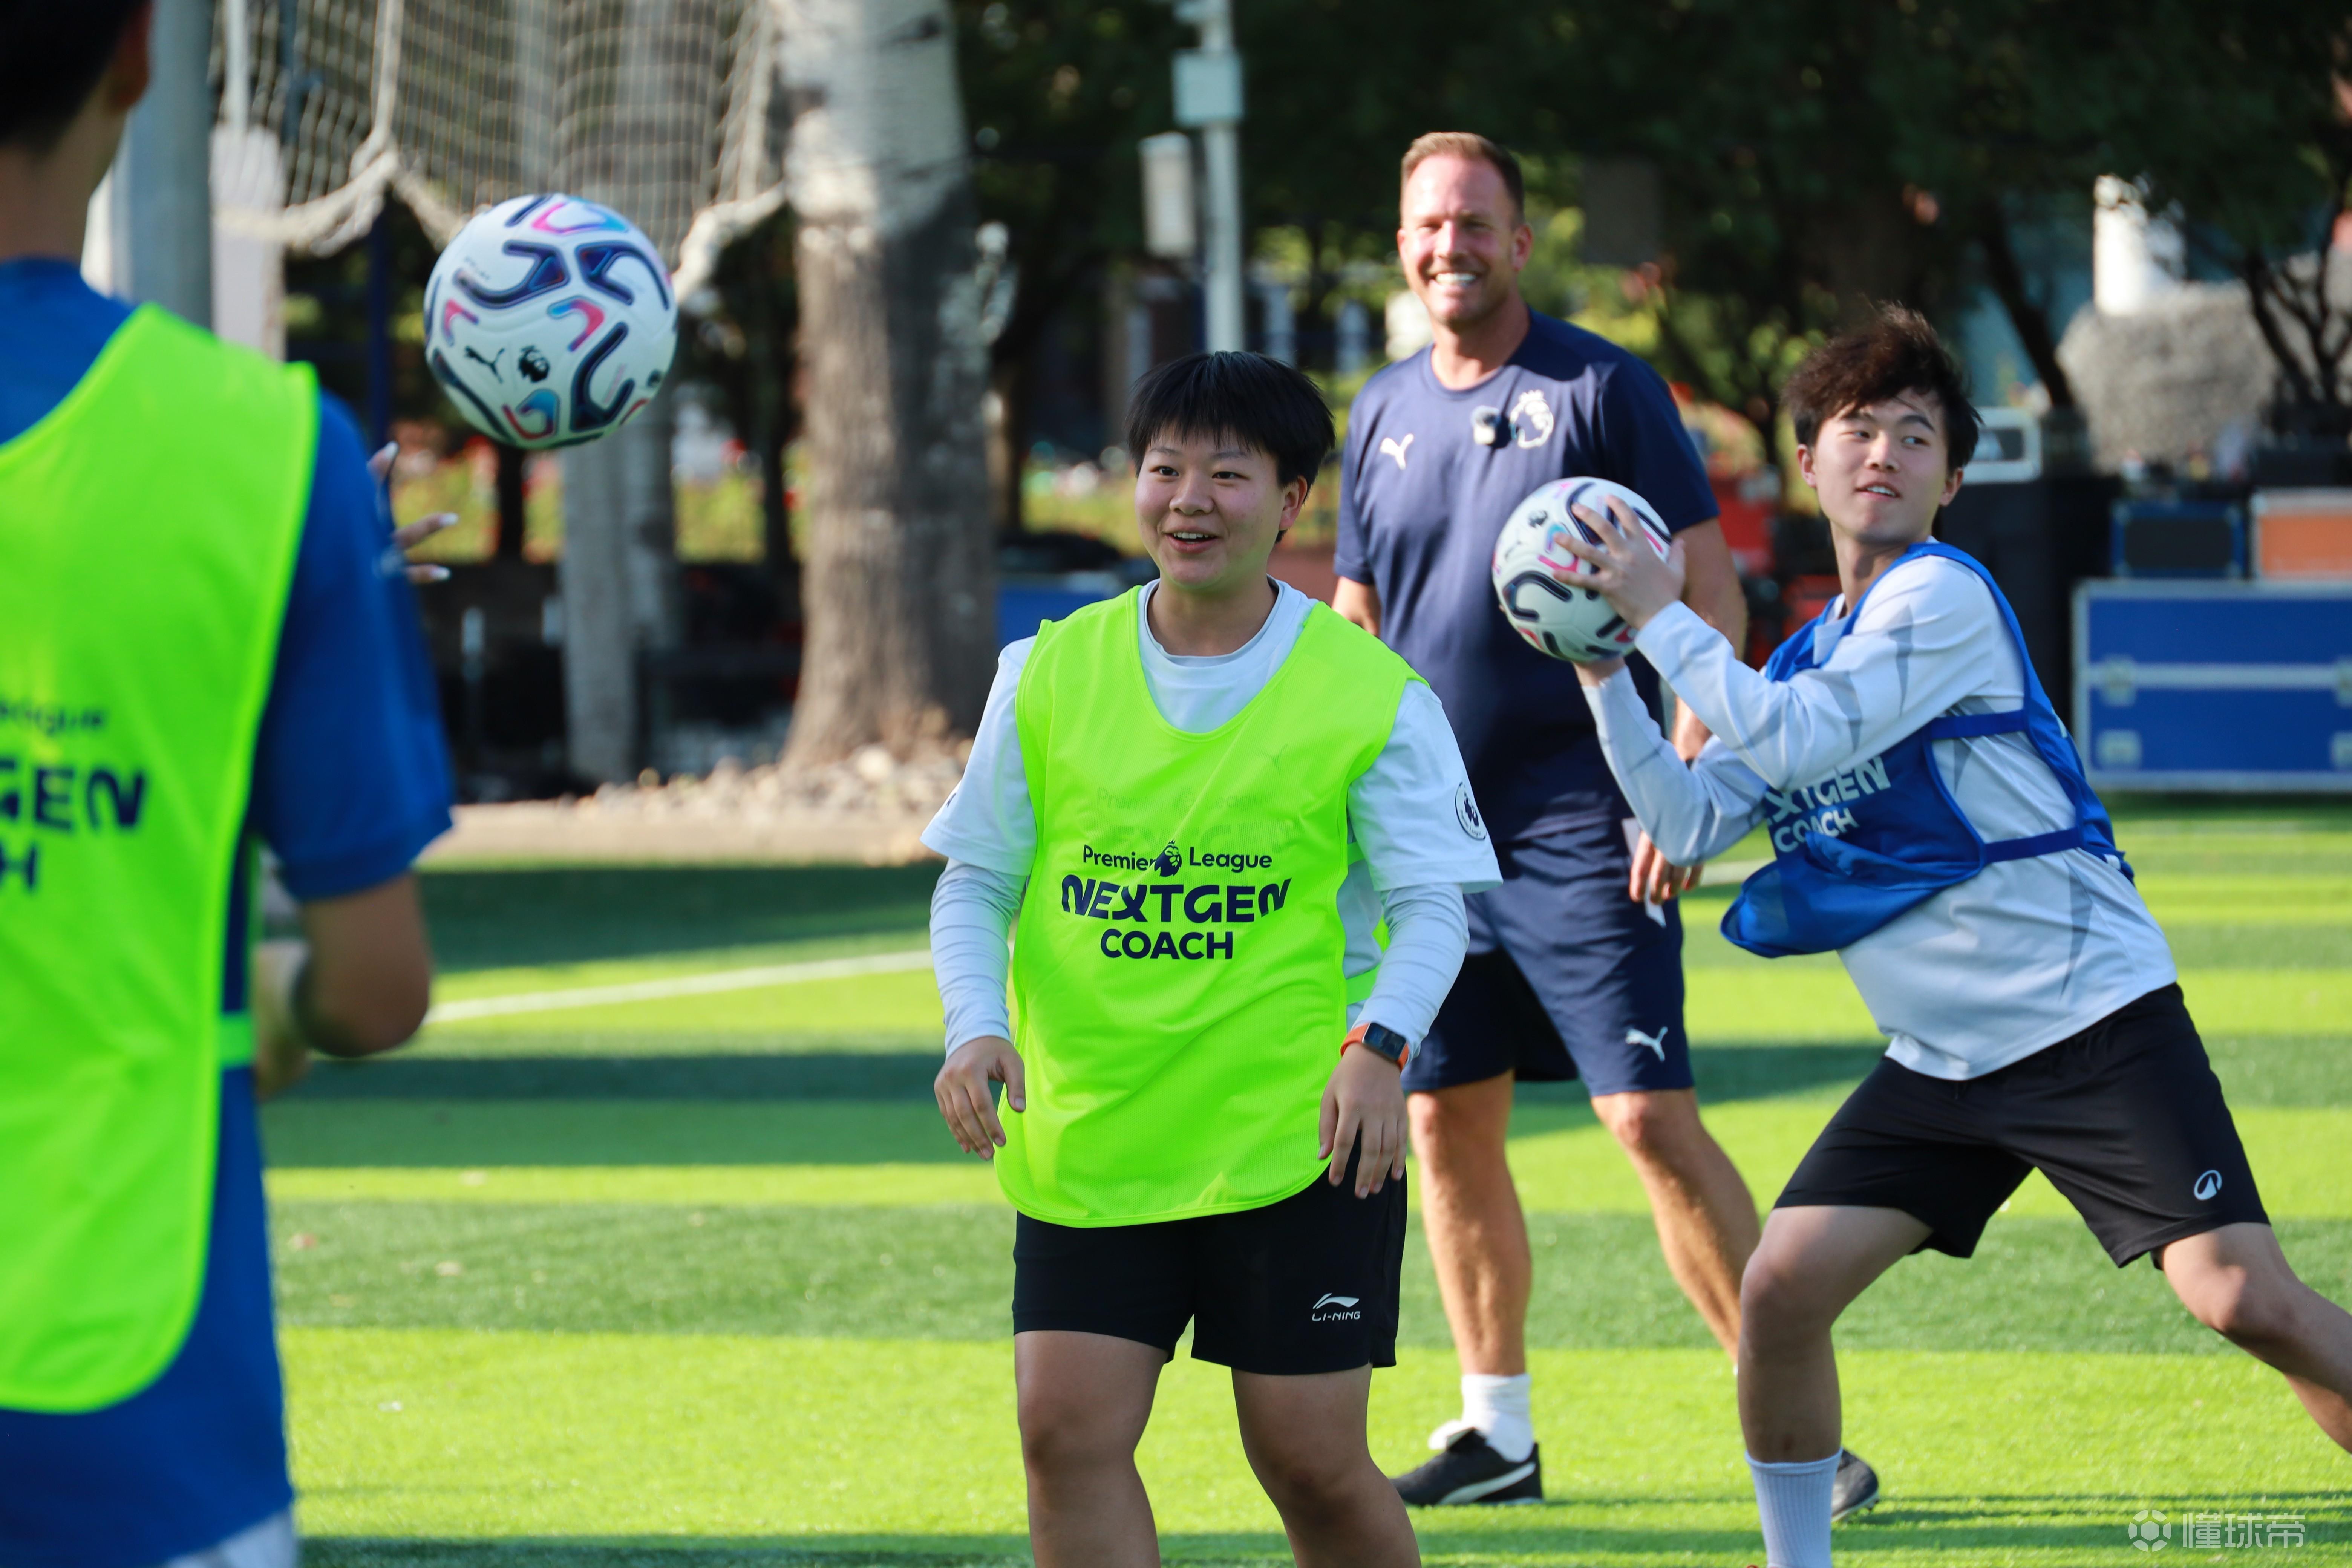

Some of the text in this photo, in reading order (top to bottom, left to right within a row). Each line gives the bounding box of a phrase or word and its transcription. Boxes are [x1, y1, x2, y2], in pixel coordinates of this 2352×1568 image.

[1083, 844, 1272, 873] Premier League
[1061, 874, 1292, 923] NEXTGEN
[1100, 928, 1234, 960] COACH
[1312, 1311, 1360, 1321] LI-NING
